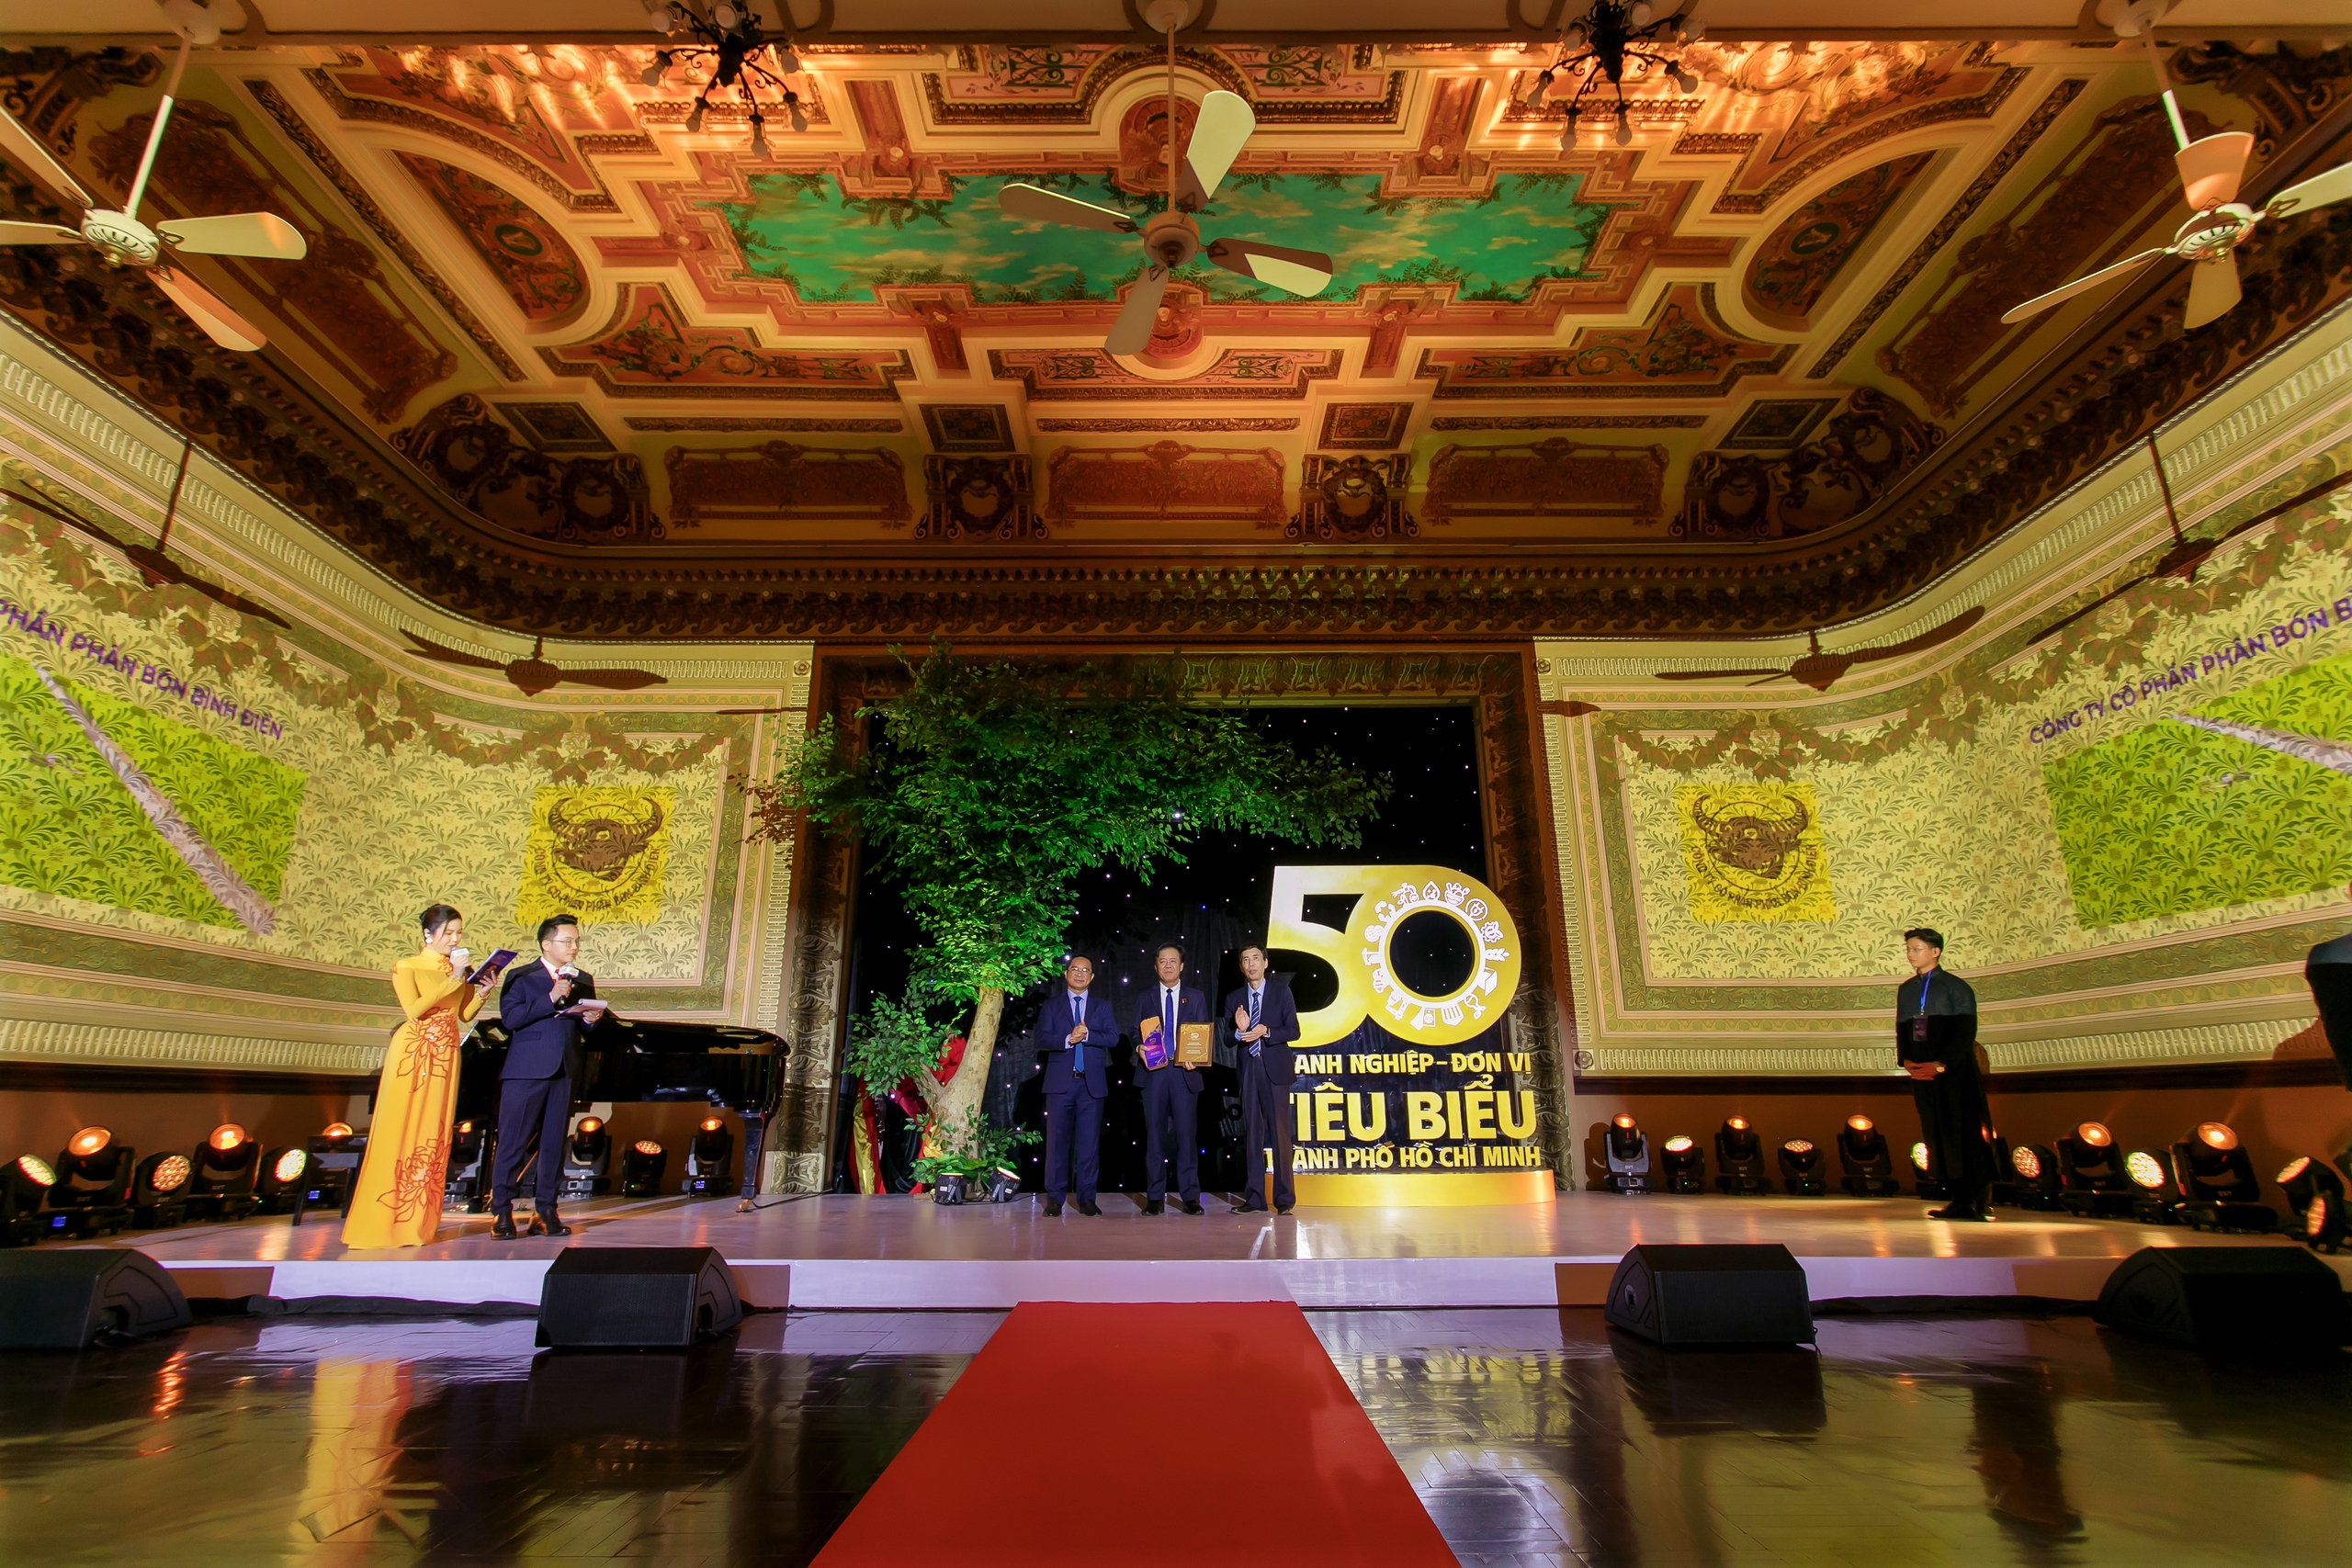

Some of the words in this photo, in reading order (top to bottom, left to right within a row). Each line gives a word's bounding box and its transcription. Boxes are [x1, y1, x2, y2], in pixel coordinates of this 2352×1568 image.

[141, 664, 187, 699] BÓN
[190, 687, 238, 721] BÌNH
[2030, 712, 2083, 744] CÔNG
[2084, 699, 2105, 721] TY
[2200, 636, 2267, 675] PHÂN
[2270, 610, 2329, 649] BÓN
[1267, 865, 1521, 1047] 50
[1295, 1054, 1342, 1074] ANH
[1508, 1053, 1532, 1074] VỊ
[1289, 1082, 1386, 1142] IÊU
[1407, 1074, 1537, 1140] BIỂU
[1345, 1142, 1395, 1168] PHỐ
[1400, 1141, 1433, 1168] HỒ
[1440, 1143, 1476, 1168] CHÍ
[1483, 1146, 1541, 1167] MINH
